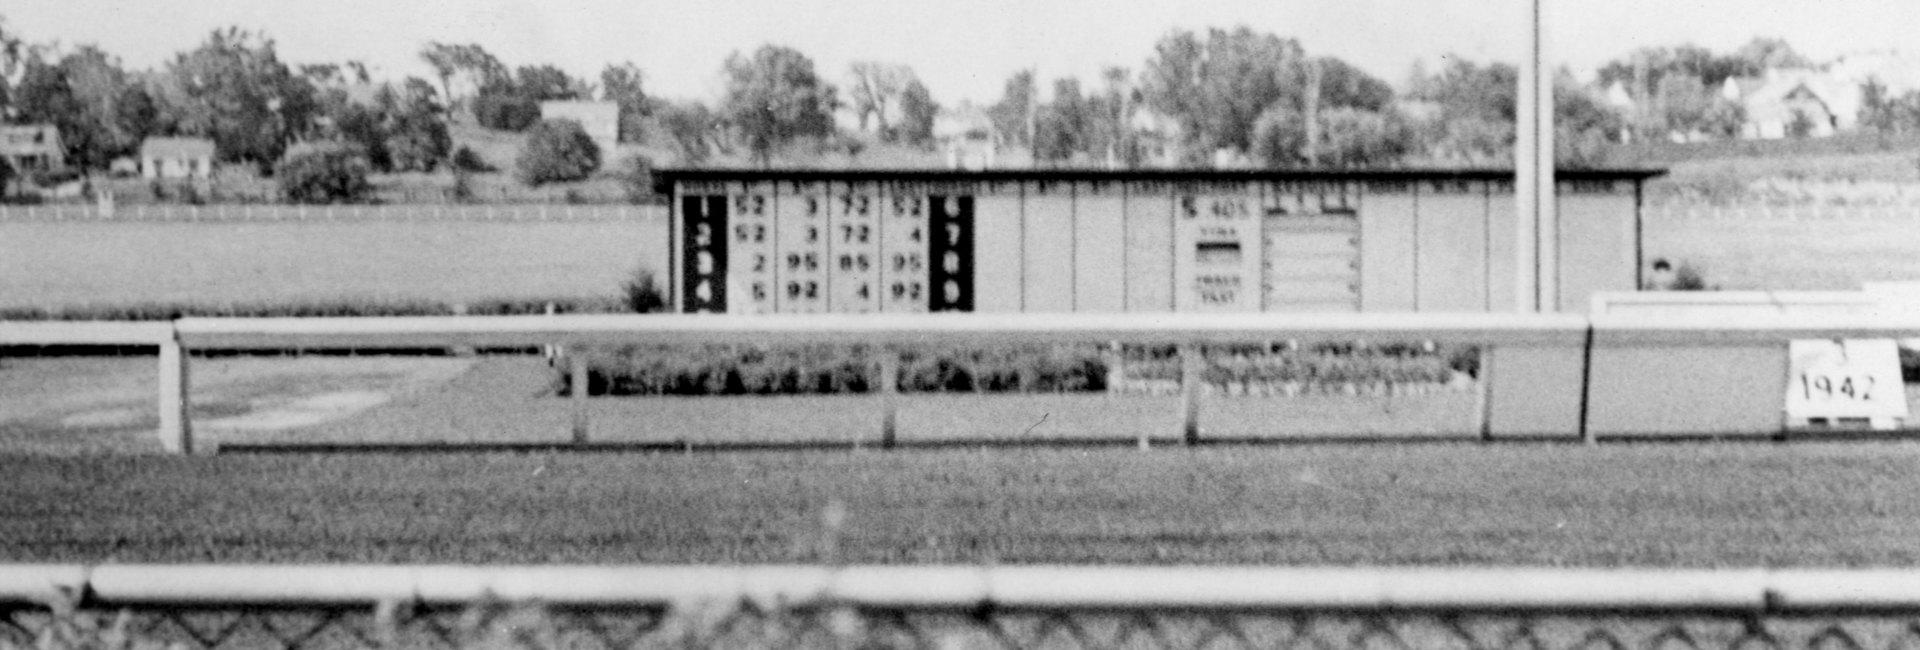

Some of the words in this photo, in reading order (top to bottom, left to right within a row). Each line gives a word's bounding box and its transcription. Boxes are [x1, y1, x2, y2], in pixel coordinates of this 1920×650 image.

[701, 196, 708, 217] 1
[696, 222, 711, 246] 2
[945, 222, 960, 245] 7
[696, 279, 711, 302] 4
[1801, 374, 1875, 401] 1942
